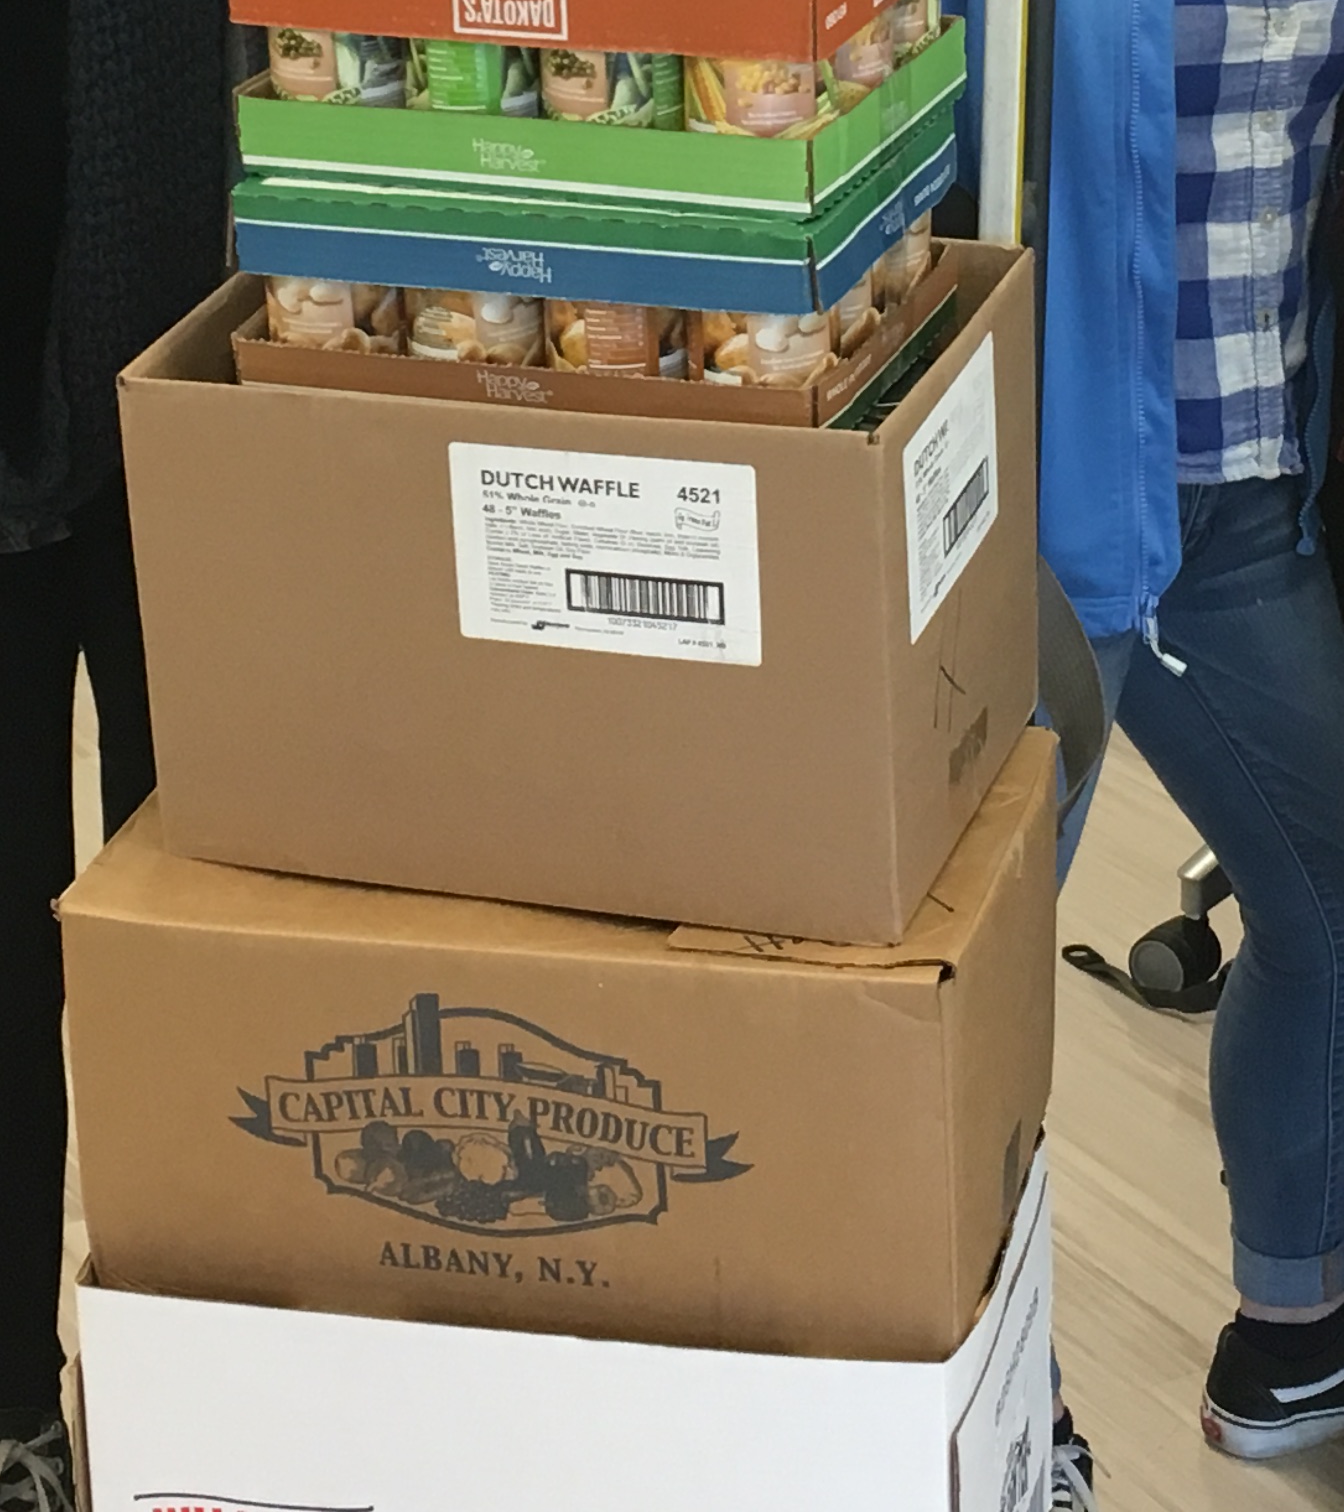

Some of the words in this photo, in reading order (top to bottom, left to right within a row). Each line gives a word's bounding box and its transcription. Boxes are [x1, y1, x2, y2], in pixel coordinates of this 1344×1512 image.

[472, 137, 522, 159] Happy
[500, 261, 552, 284] Happy
[476, 369, 528, 389] Happy
[481, 469, 555, 492] DUTCH
[557, 475, 641, 500] WAFFLE
[676, 486, 721, 505] 4521
[506, 492, 540, 504] Whole
[542, 496, 572, 507] Grain
[520, 507, 562, 520] Waffles
[277, 1086, 425, 1125] CAPITAL
[433, 1086, 517, 1123] CITY
[526, 1094, 696, 1160] PRODUCE
[378, 1240, 525, 1284] ALBANY,
[537, 1254, 611, 1288] N.Y.
